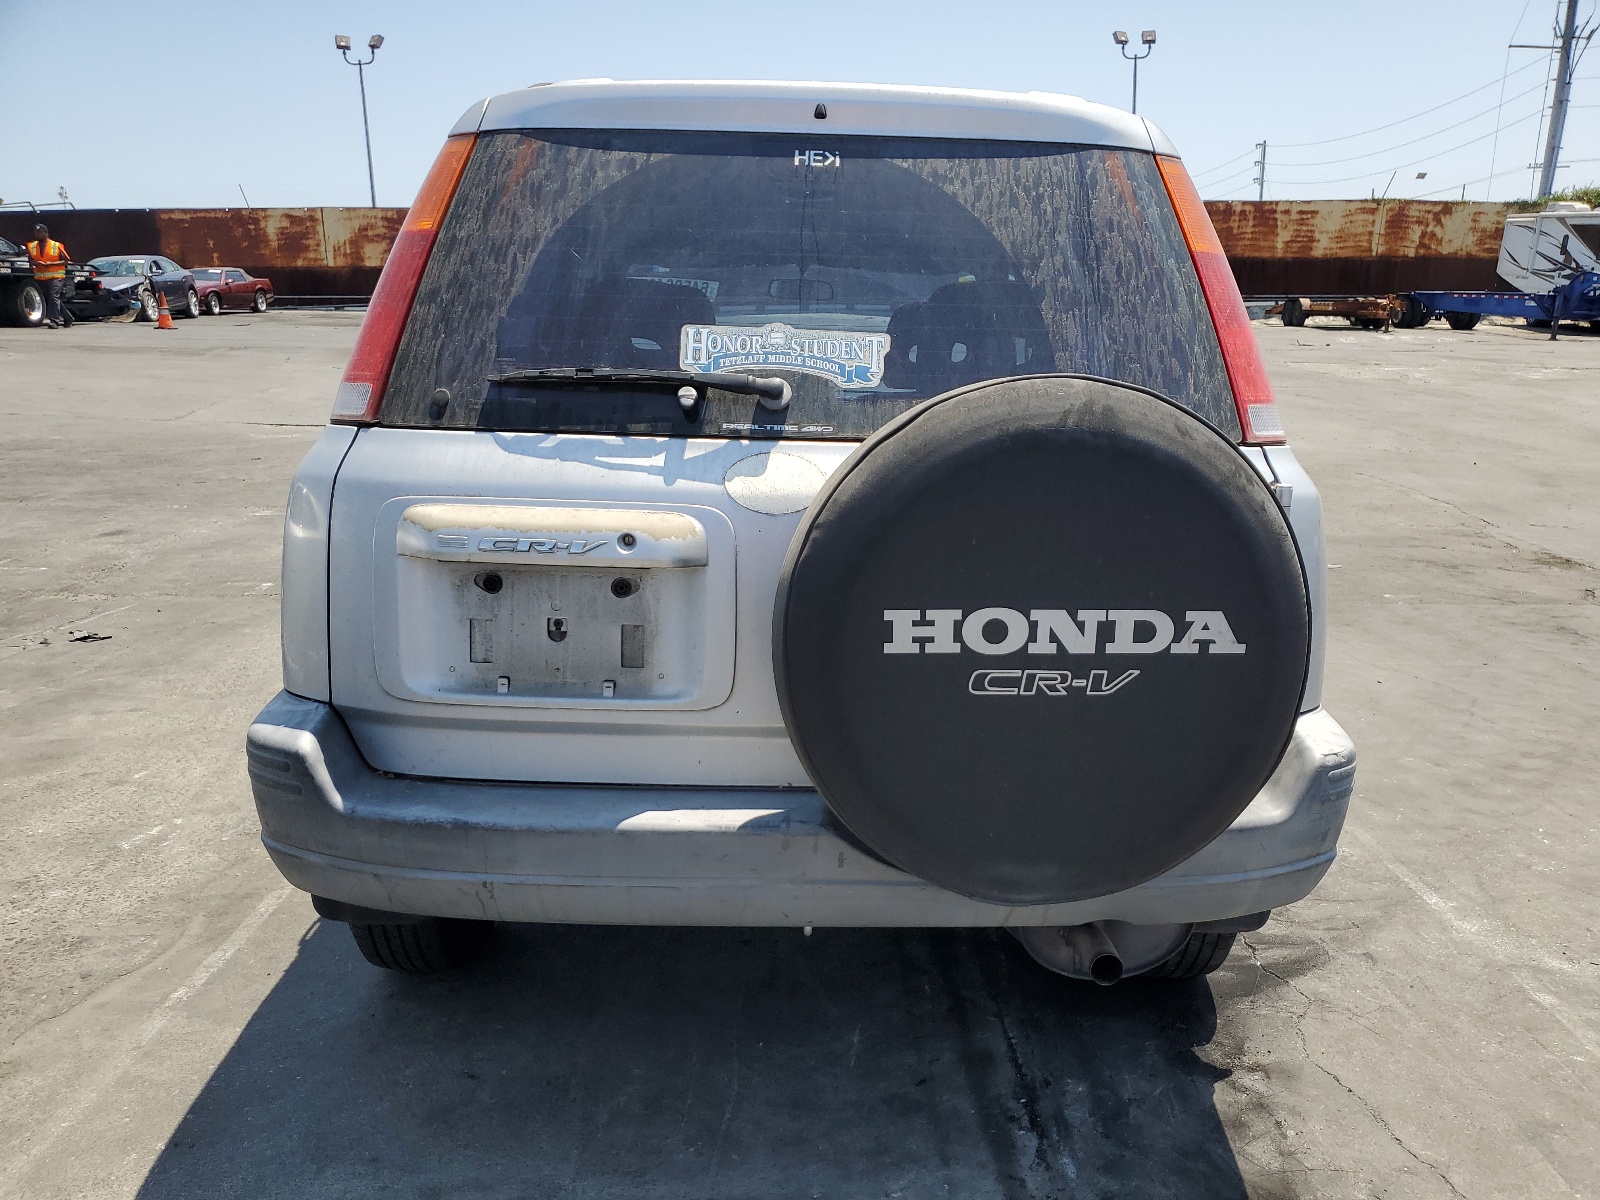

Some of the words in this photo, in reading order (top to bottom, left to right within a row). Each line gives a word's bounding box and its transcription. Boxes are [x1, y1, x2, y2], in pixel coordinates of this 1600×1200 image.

[684, 327, 764, 364] HONOR
[790, 336, 886, 373] STUDENT
[719, 354, 766, 367] TETZLAFF
[767, 354, 804, 364] MIDDLE
[805, 357, 841, 373] SCHOOL
[478, 537, 609, 554] CR-V
[883, 607, 1247, 655] HONDA
[968, 669, 1141, 696] CR-V
